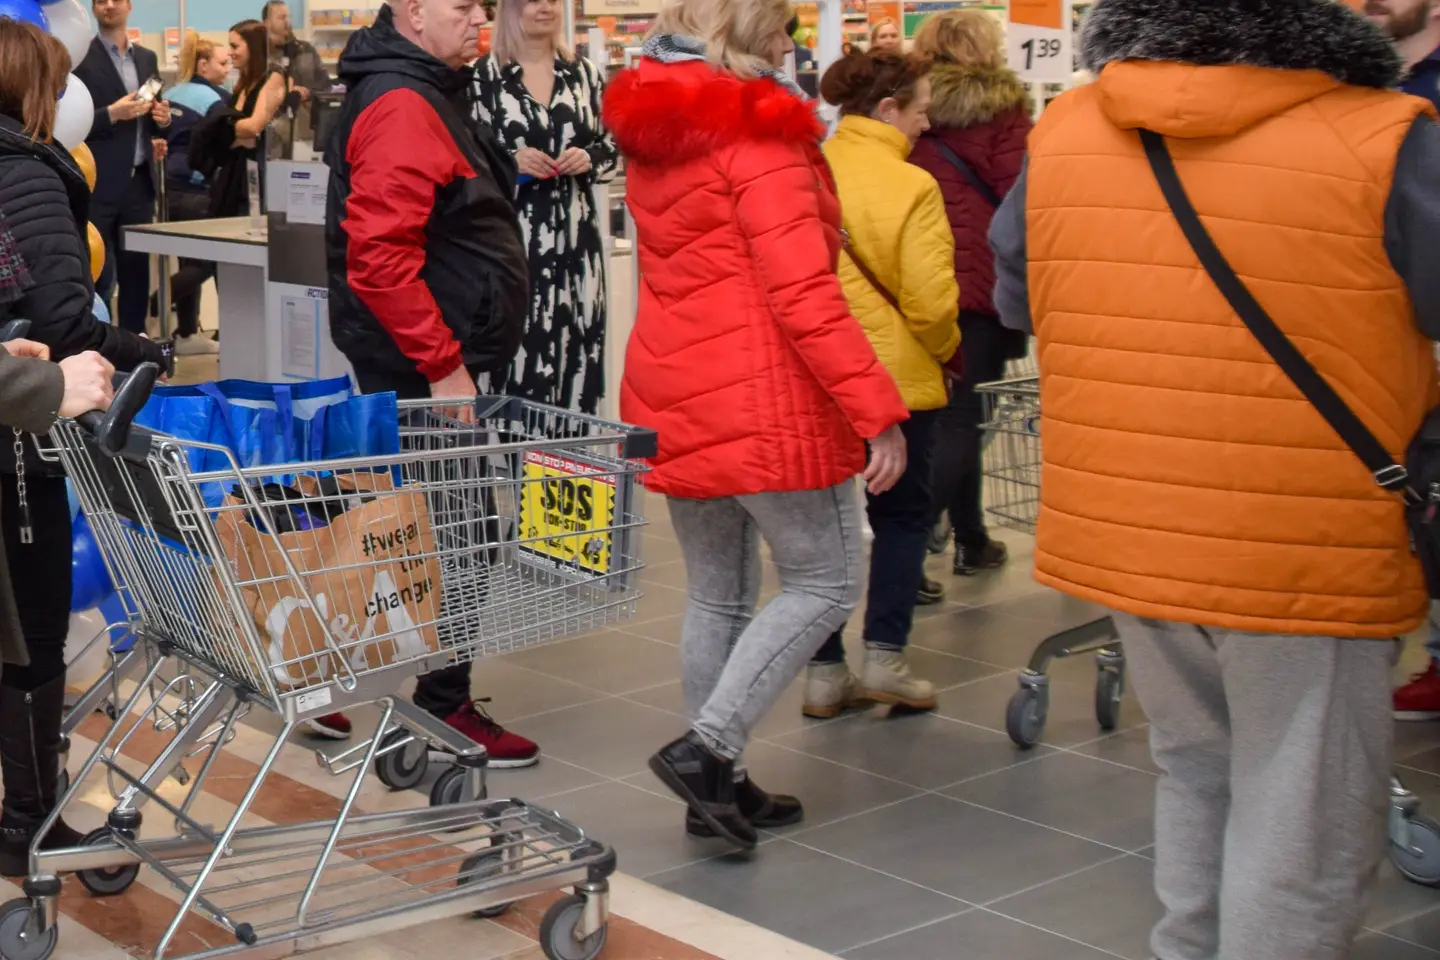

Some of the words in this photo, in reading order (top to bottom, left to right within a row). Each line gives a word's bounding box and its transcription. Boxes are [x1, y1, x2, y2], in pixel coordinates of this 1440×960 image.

[308, 288, 329, 299] ACTIO
[527, 451, 543, 462] NON
[544, 456, 565, 467] STOP
[541, 474, 593, 521] SOS
[364, 577, 433, 617] change
[264, 569, 432, 686] C&A
